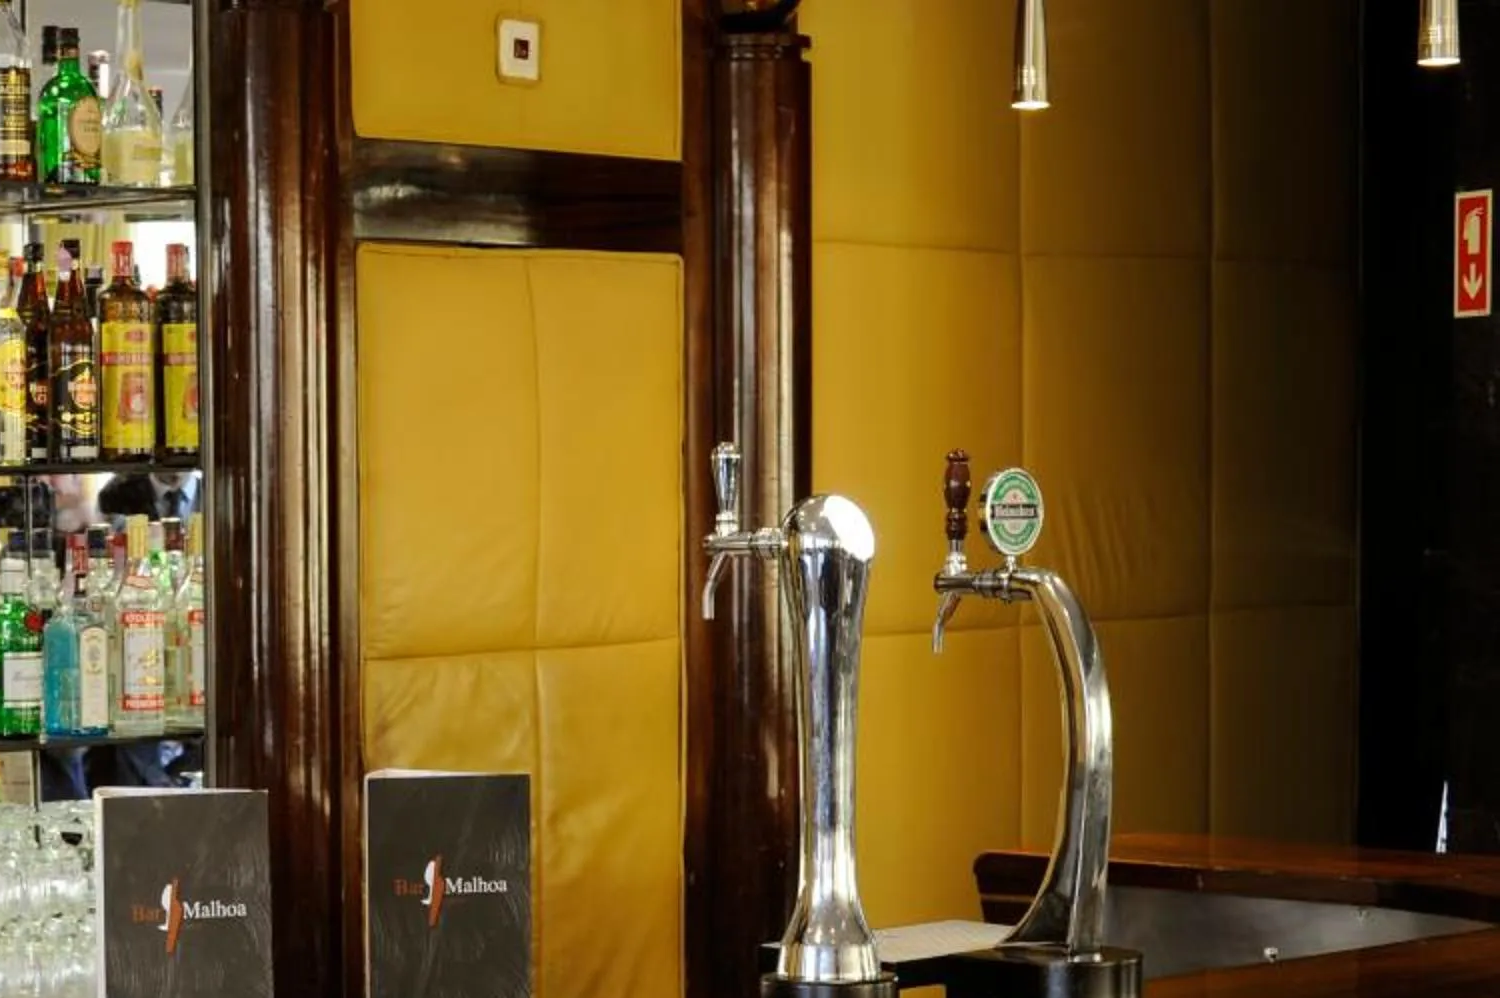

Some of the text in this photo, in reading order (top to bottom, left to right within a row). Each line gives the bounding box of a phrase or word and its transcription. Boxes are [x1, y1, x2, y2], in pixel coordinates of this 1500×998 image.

[392, 876, 508, 896] Bar Malhoa
[131, 900, 247, 922] Bar Malhoa
